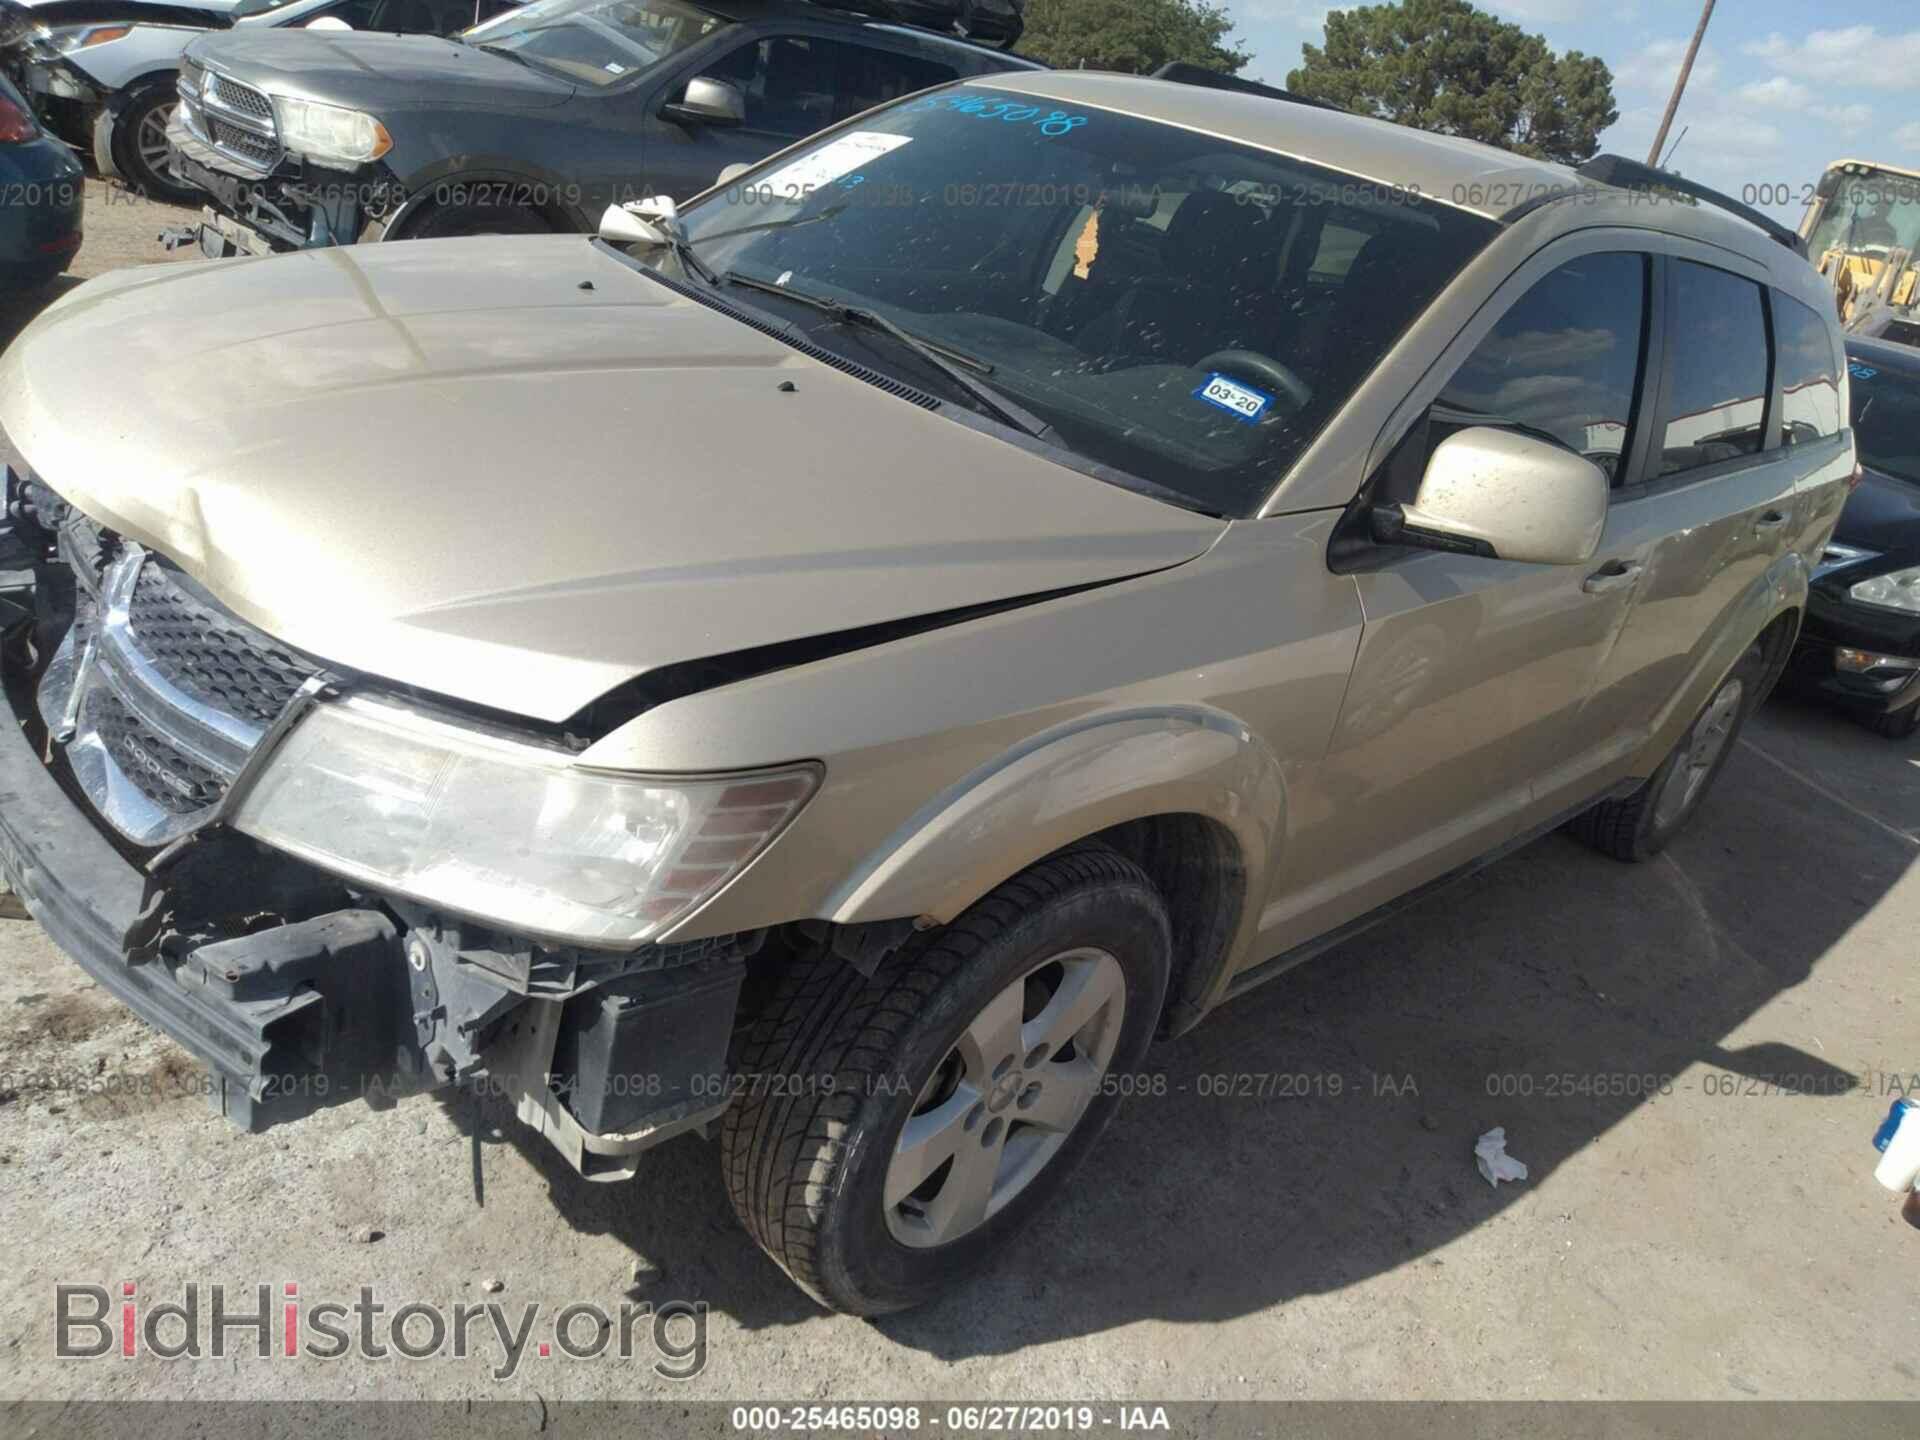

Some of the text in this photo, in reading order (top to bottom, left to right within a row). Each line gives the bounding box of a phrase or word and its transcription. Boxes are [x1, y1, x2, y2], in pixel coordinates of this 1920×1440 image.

[906, 94, 1089, 136] 5465098
[1209, 384, 1231, 400] 03
[1235, 396, 1258, 412] 20
